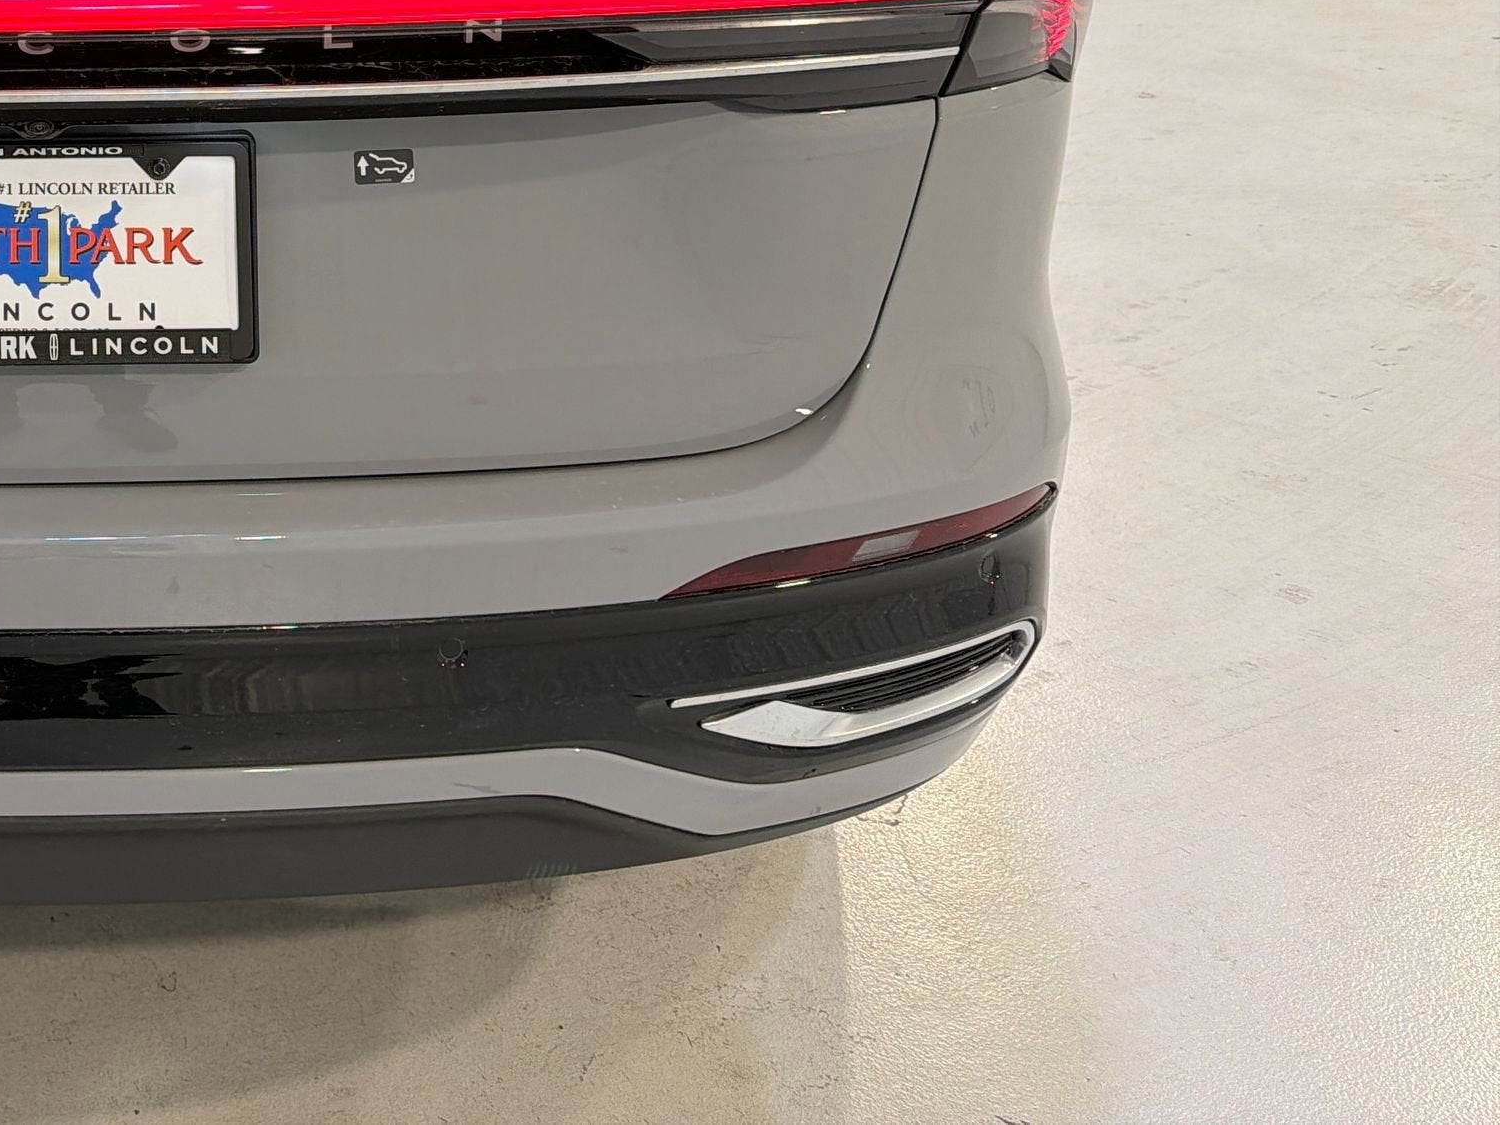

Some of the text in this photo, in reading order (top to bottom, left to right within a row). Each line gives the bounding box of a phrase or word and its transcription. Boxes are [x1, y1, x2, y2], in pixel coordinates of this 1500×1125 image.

[12, 146, 123, 156] ANTONIO
[18, 182, 94, 196] LINCOLN
[98, 182, 176, 196] RETAILER
[68, 226, 204, 266] PARK
[70, 336, 219, 356] LINCOLN
